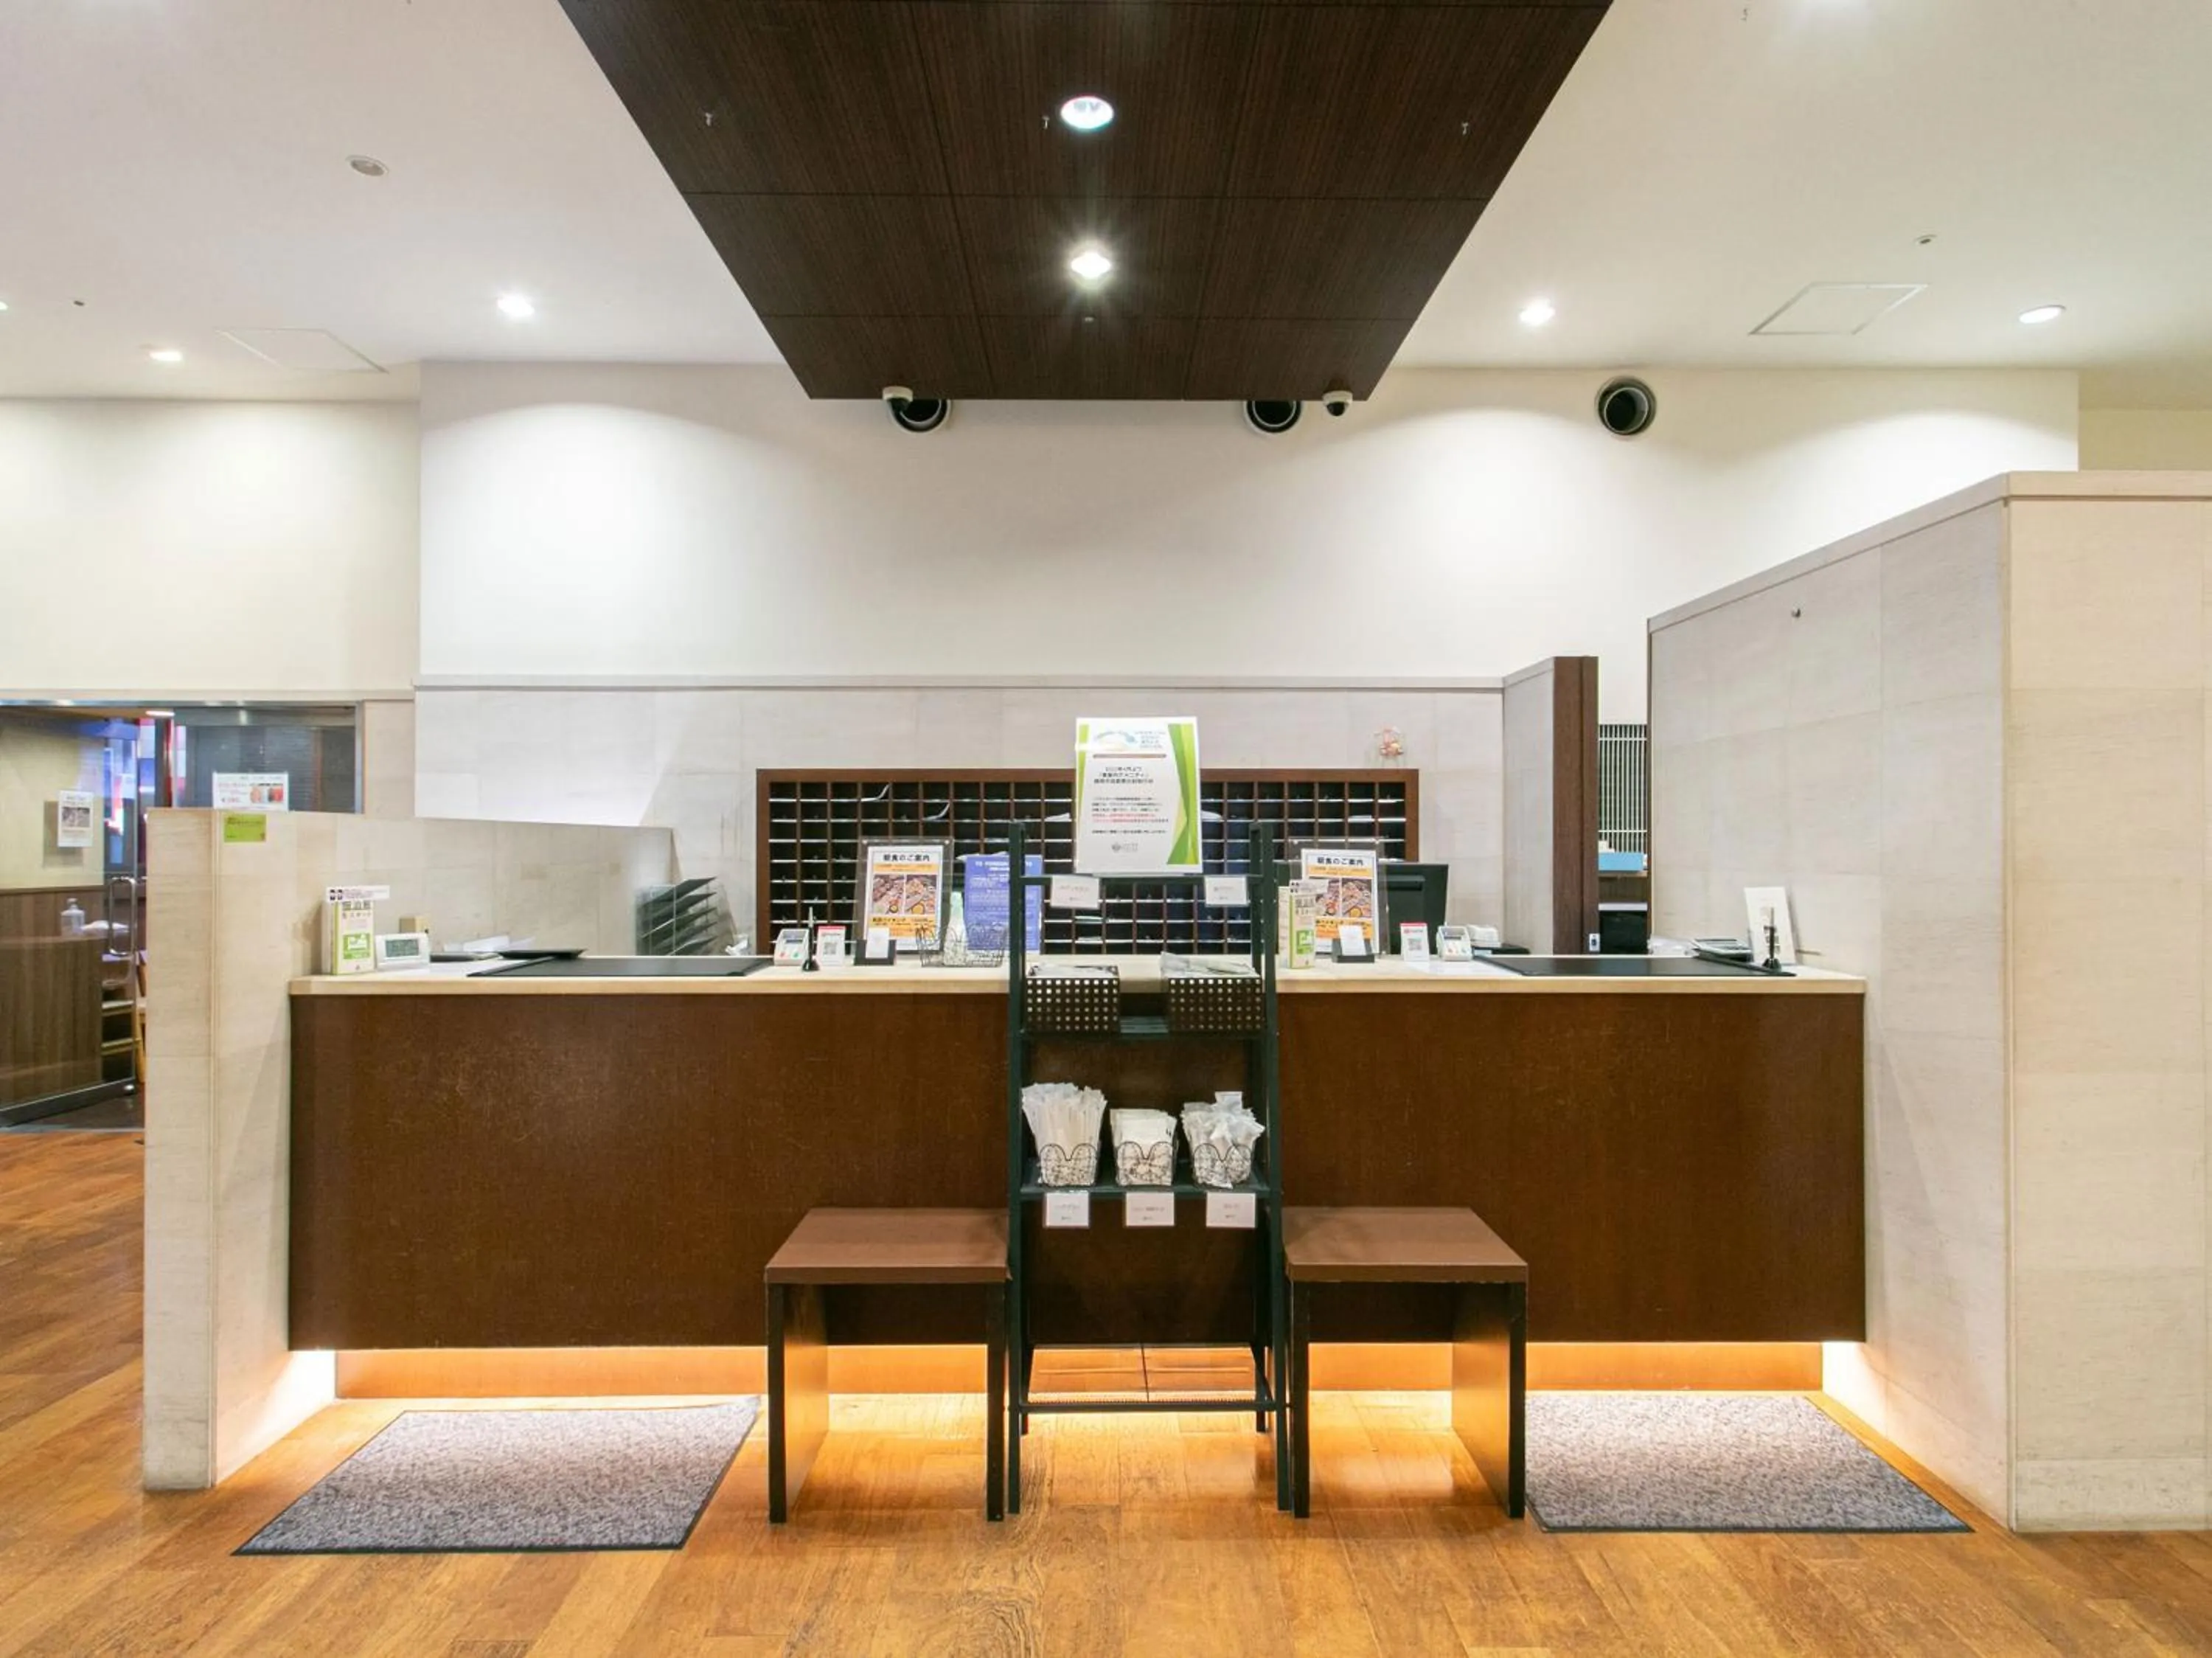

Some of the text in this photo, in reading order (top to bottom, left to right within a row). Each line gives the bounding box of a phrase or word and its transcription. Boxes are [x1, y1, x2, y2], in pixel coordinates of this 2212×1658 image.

[883, 853, 930, 862] 朝食のご案内
[1317, 856, 1363, 866] 朝食のご案内
